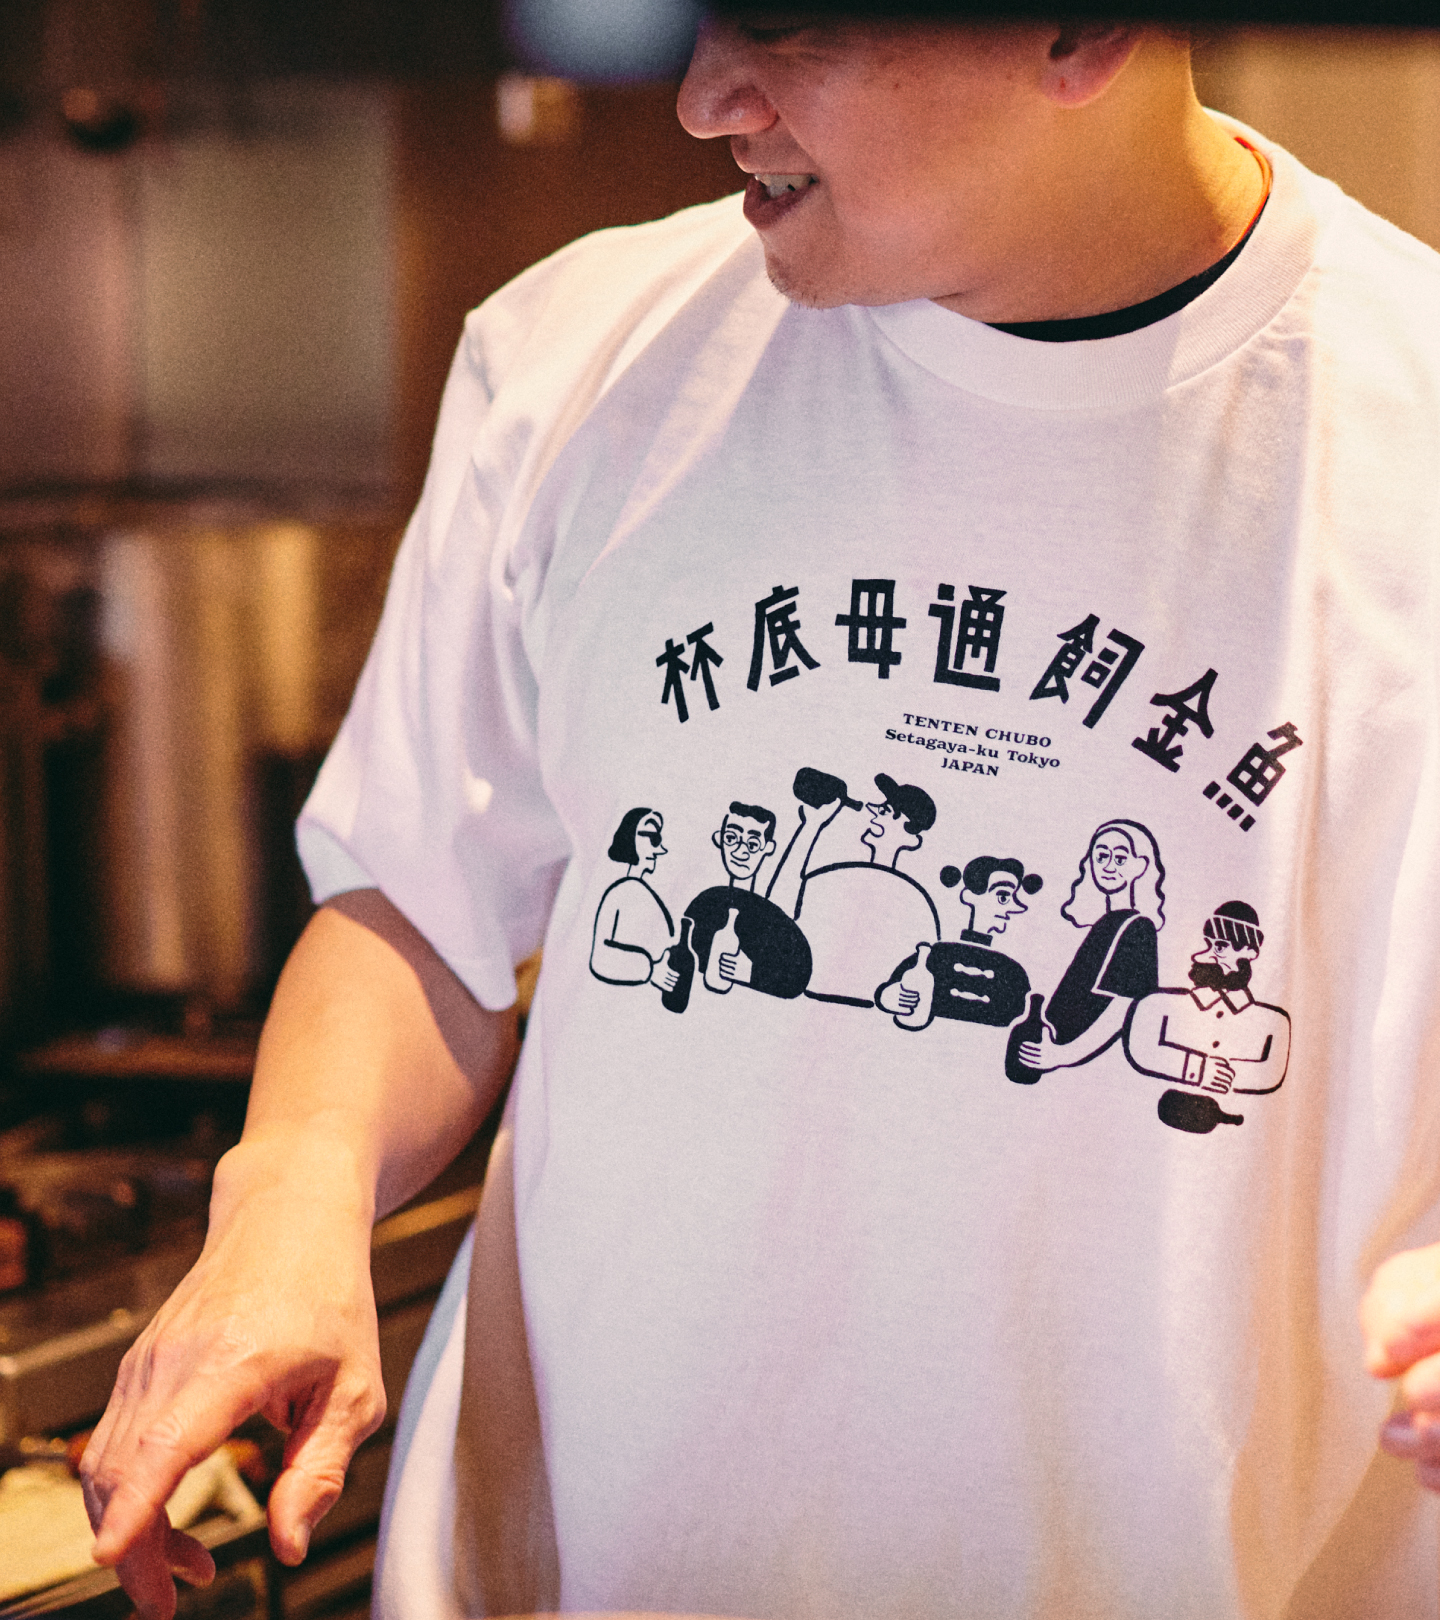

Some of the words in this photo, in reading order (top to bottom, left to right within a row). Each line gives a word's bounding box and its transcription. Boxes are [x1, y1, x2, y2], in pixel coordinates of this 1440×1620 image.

[903, 713, 979, 737] TENTEN
[984, 728, 1052, 748] CHUBO
[885, 728, 999, 759] Setagaya-ku
[1006, 749, 1061, 769] Tokyo
[940, 757, 1000, 777] JAPAN
